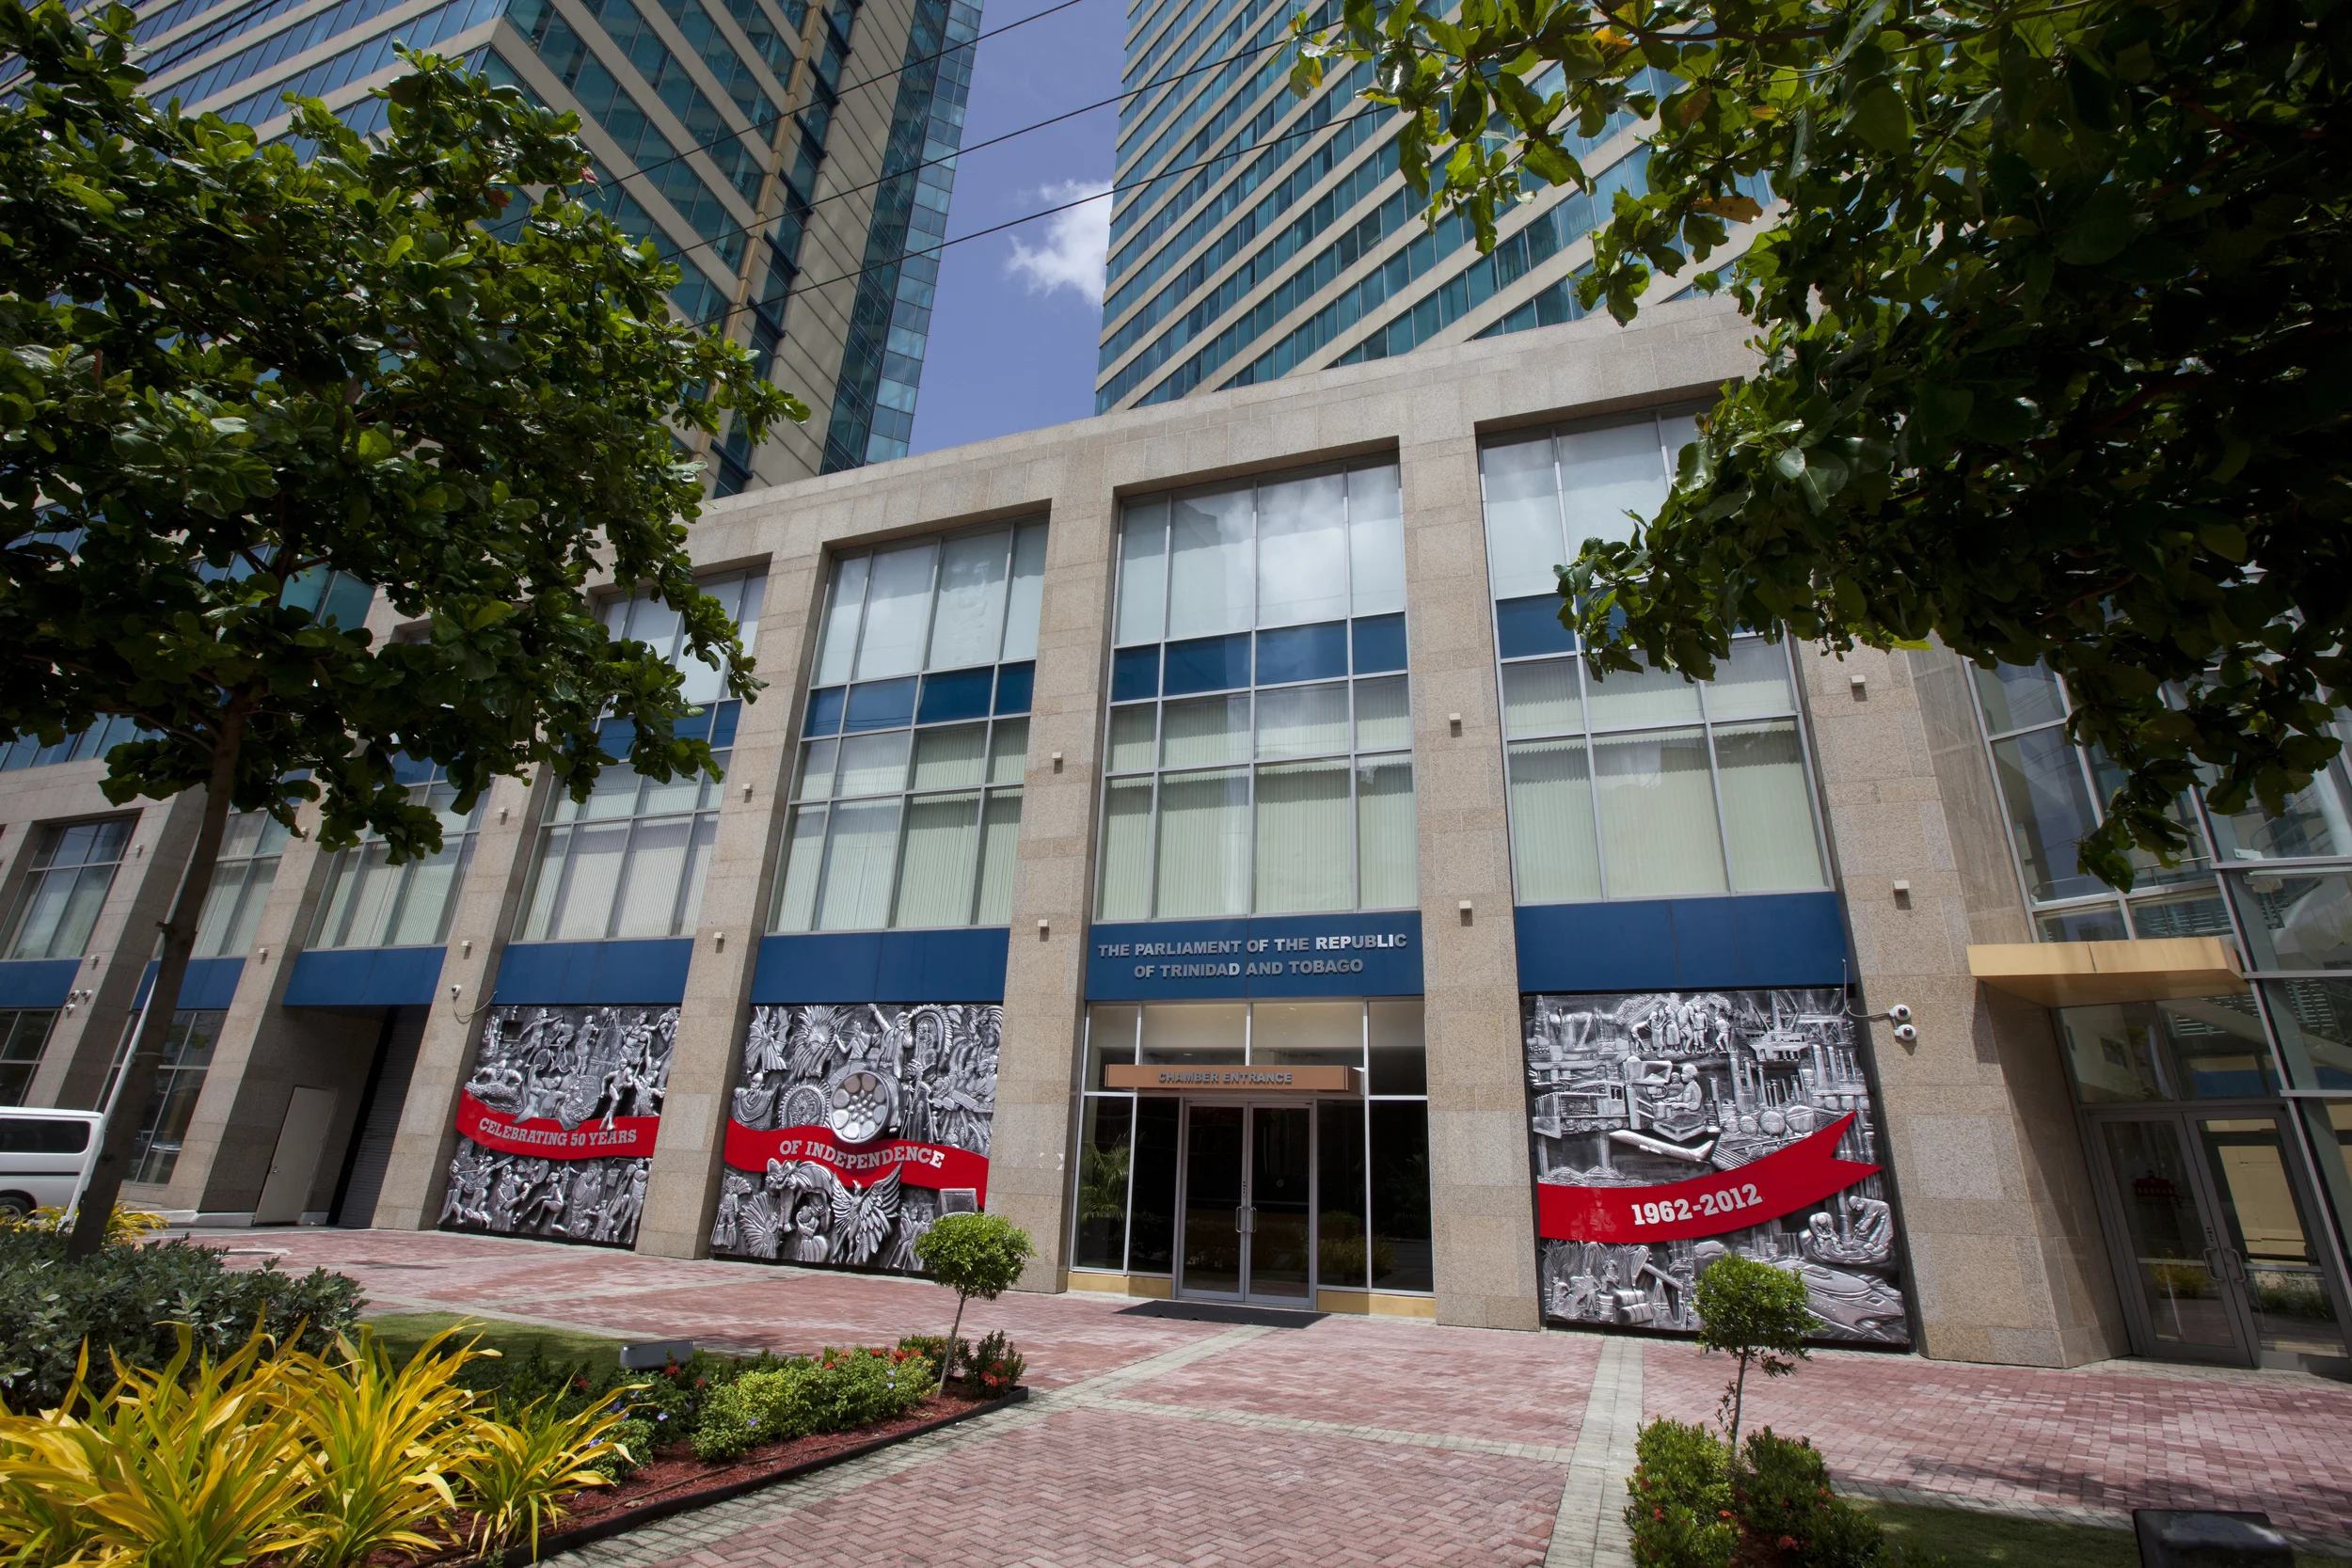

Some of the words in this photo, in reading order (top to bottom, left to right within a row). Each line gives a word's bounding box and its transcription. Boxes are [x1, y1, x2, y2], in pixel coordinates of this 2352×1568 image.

[1098, 944, 1129, 958] THE
[1135, 941, 1242, 956] PARLIAMENT
[1247, 939, 1268, 953] OF
[1274, 938, 1310, 951] THE
[1316, 933, 1407, 950] REPUBLIC
[1134, 965, 1155, 978] OF
[1160, 962, 1240, 977] TRINIDAD
[1246, 961, 1283, 975] AND
[1289, 958, 1364, 974] TOBAGO
[1158, 1072, 1219, 1084] CHAMBER
[1223, 1072, 1293, 1085] ENTRANCE
[479, 1117, 567, 1146] CELEBRATING
[570, 1132, 586, 1147] 50
[589, 1130, 637, 1146] YEARS
[779, 1140, 803, 1155] OF
[804, 1141, 946, 1169] INDEPENDENCE
[1630, 1183, 1764, 1226] 1962-2012
